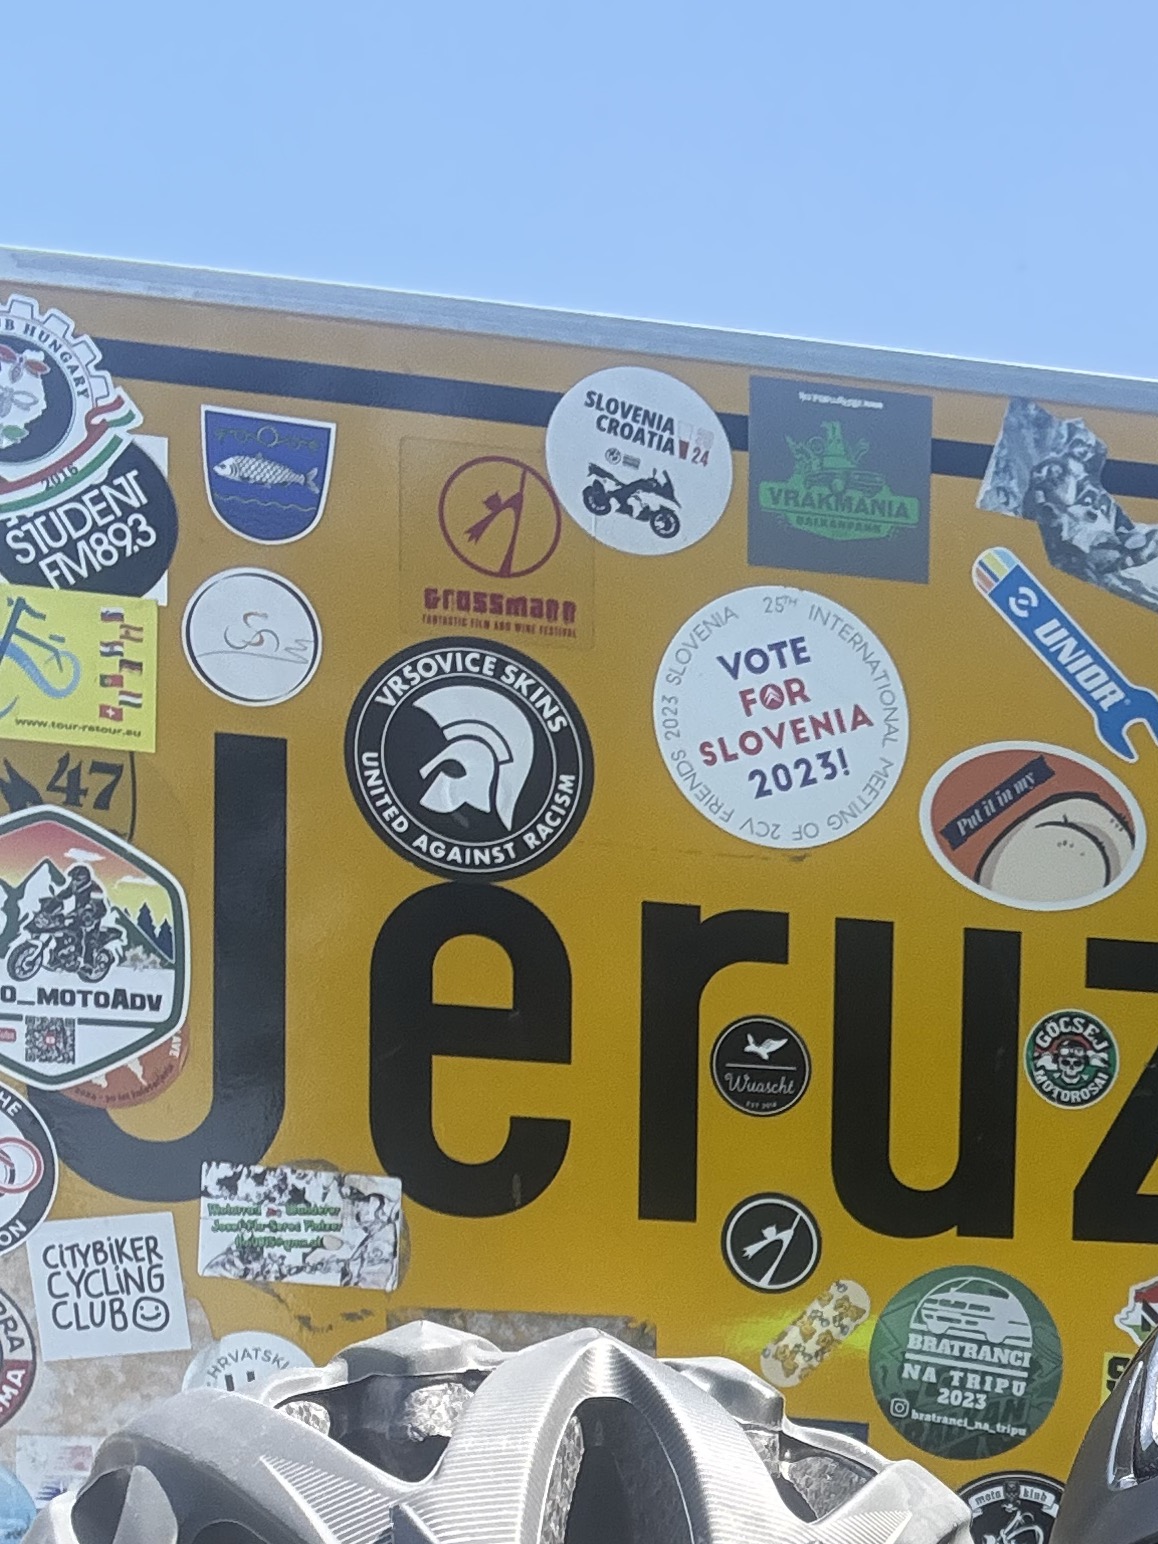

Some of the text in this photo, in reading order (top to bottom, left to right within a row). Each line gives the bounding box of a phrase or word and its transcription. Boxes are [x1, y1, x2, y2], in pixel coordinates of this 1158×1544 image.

[24, 323, 90, 399] HUNGARY
[584, 390, 675, 436] SLOVENIA
[596, 414, 675, 456] CROATIA
[6, 470, 149, 564] STUDENT
[666, 606, 740, 686] SLOVENIA
[716, 636, 811, 681] VOTE
[1034, 618, 1126, 712] UNIOR
[500, 665, 568, 733] SKINS
[739, 677, 811, 718] FOR
[808, 604, 900, 748] INTERNATIONAL
[661, 694, 681, 741] 2023
[699, 703, 874, 767] SLOVENIA
[46, 750, 123, 811] 47
[670, 749, 736, 824] FRIENDS
[748, 747, 850, 800] 2023!
[827, 756, 895, 831] MEETING
[361, 751, 576, 866] UNITED AGAINST RACISM
[792, 821, 820, 841] OF
[52, 1297, 128, 1331] CLUB
[907, 1333, 1031, 1368] BRATRANCI
[902, 1363, 1027, 1397] NA TRIPU
[937, 1388, 987, 1410] 2023
